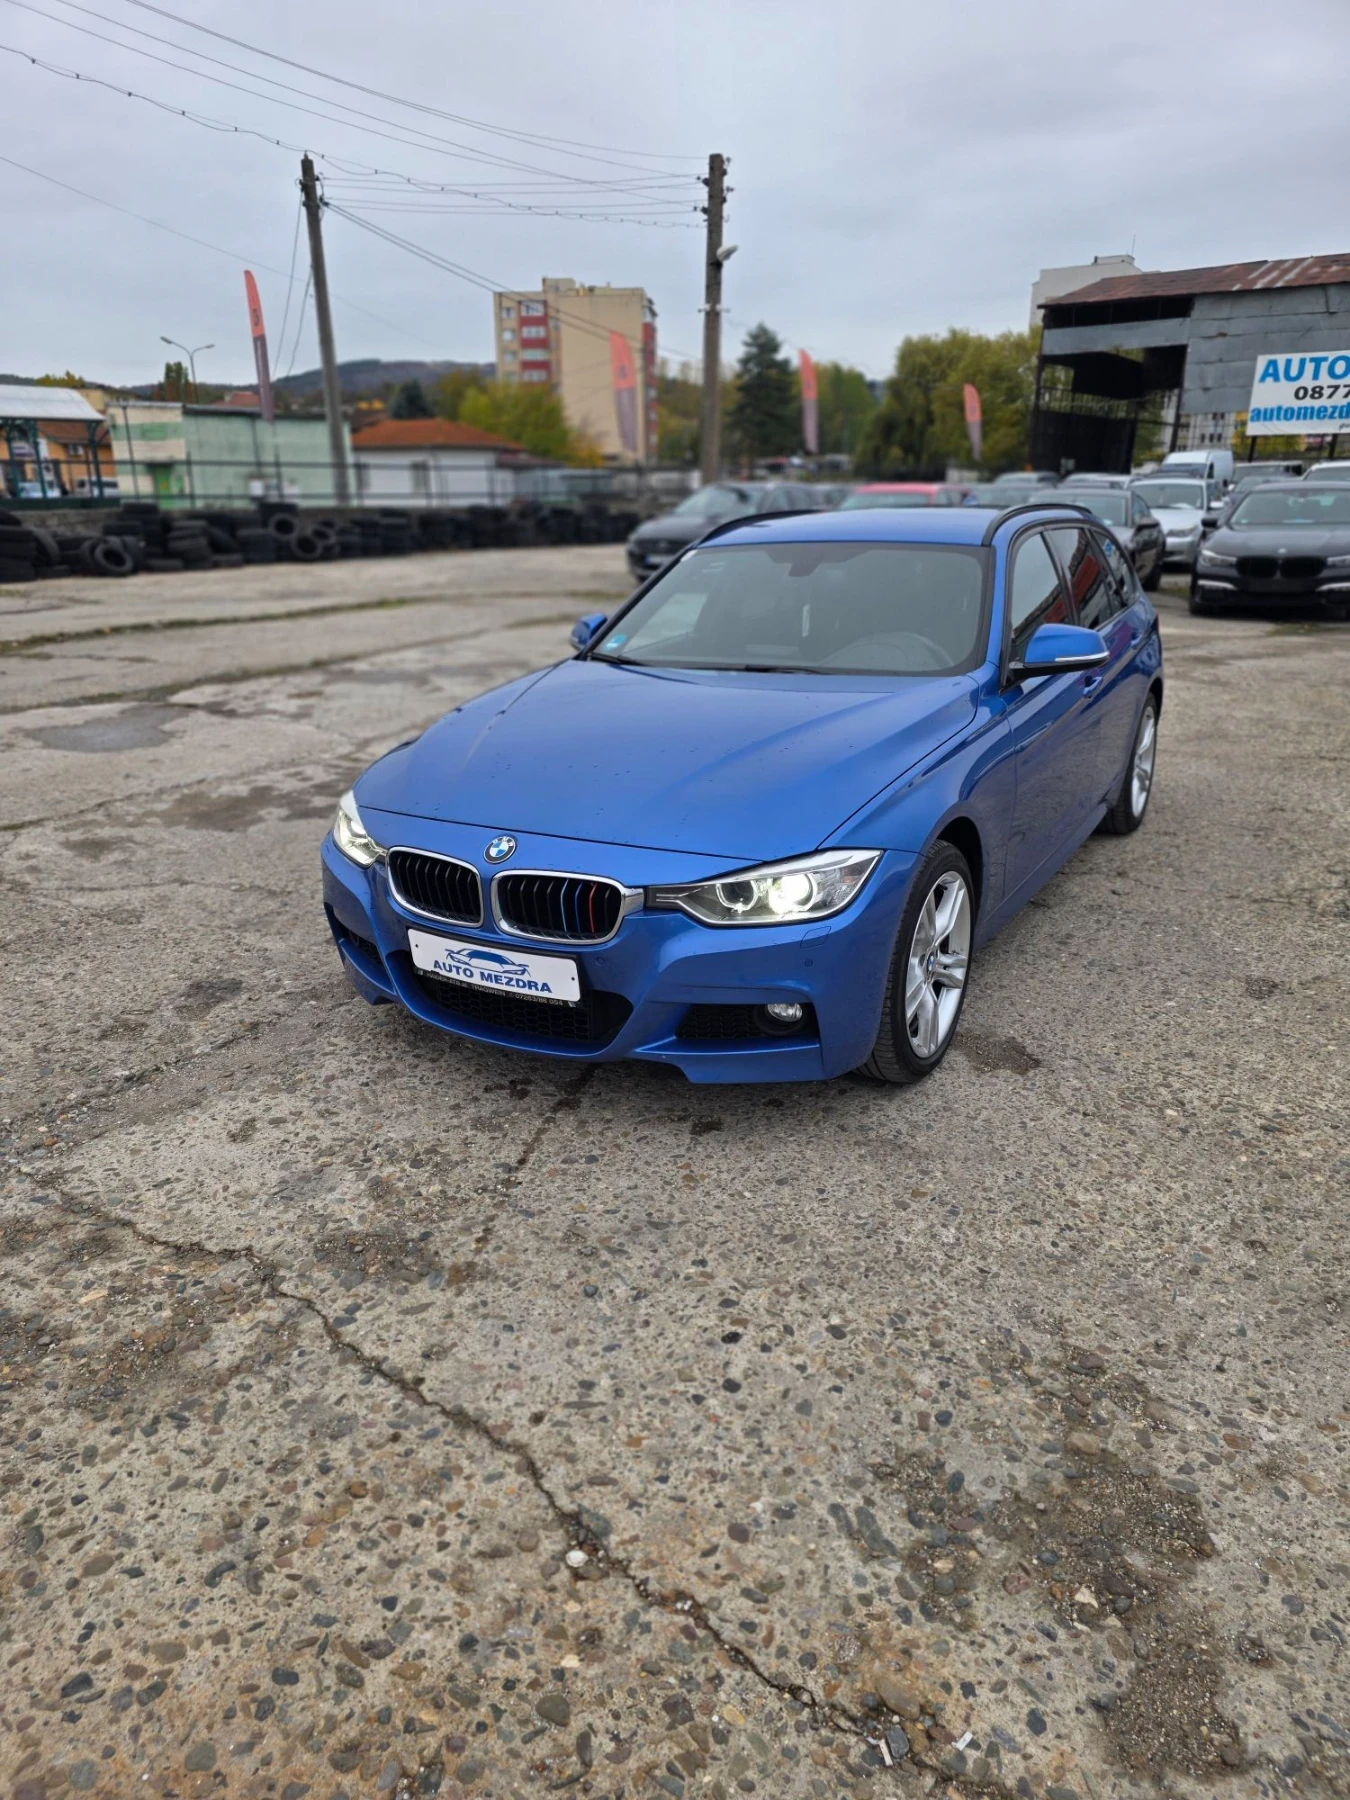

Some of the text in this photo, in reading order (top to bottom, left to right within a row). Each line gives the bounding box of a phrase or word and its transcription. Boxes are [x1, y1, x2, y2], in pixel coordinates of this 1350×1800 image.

[1258, 354, 1350, 383] AUTO
[433, 959, 475, 979] AUTO
[480, 971, 553, 994] MEZDRA
